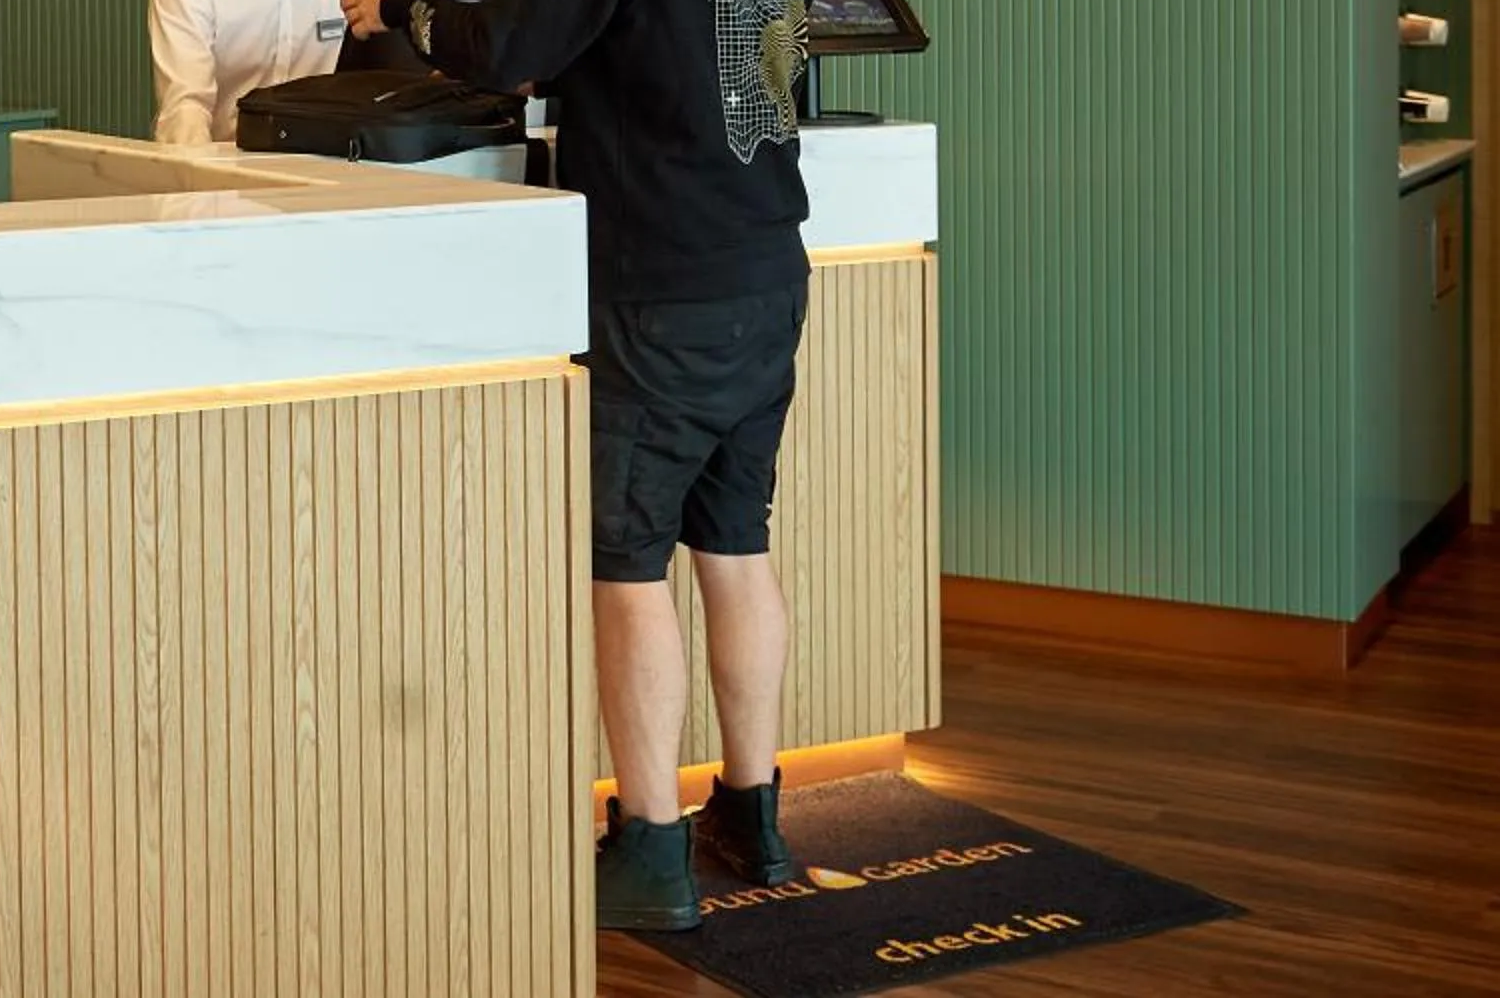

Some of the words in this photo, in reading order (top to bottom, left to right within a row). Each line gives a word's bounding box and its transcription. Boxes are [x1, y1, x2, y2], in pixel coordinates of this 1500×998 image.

[861, 841, 1034, 881] Garden
[875, 922, 1030, 963] check
[1011, 912, 1083, 933] in
